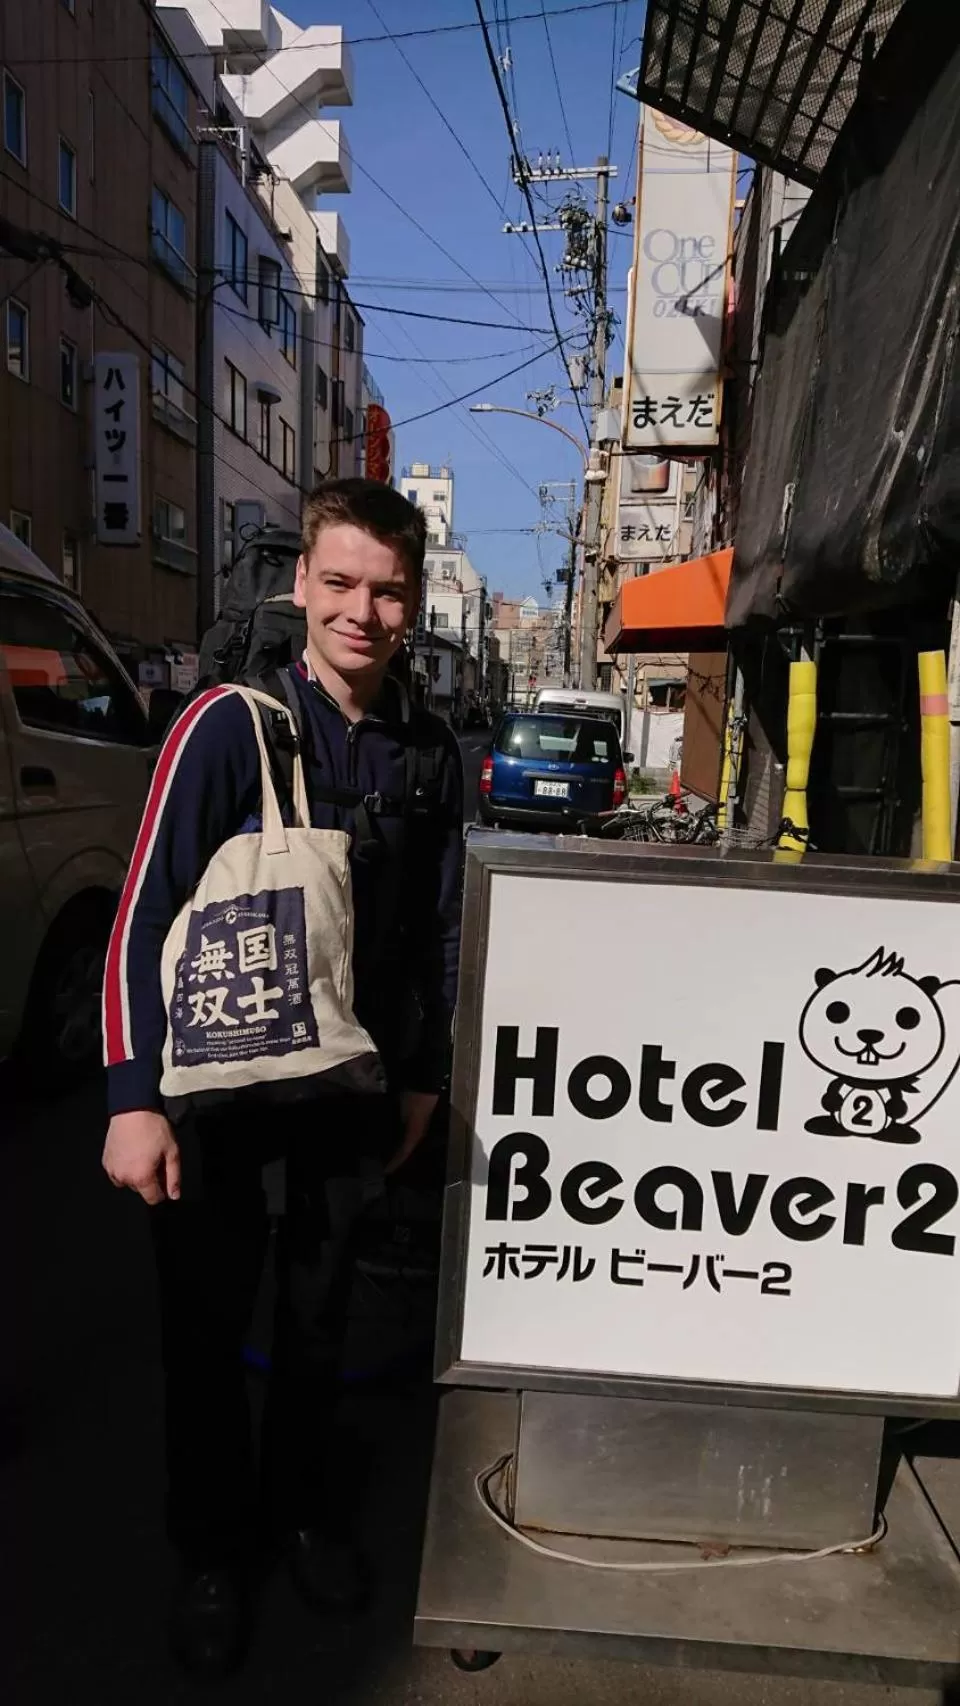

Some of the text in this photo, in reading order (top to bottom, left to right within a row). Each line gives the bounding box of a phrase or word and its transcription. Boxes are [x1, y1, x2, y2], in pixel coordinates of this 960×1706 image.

[643, 228, 715, 264] One
[651, 260, 723, 298] CUP
[631, 395, 715, 430] まえだ
[620, 524, 672, 542] まえだ
[491, 1025, 785, 1131] Hotel
[851, 1095, 874, 1127] 2
[485, 1131, 960, 1256] Beaver2
[482, 1242, 792, 1297] ホテル ビーバー2
